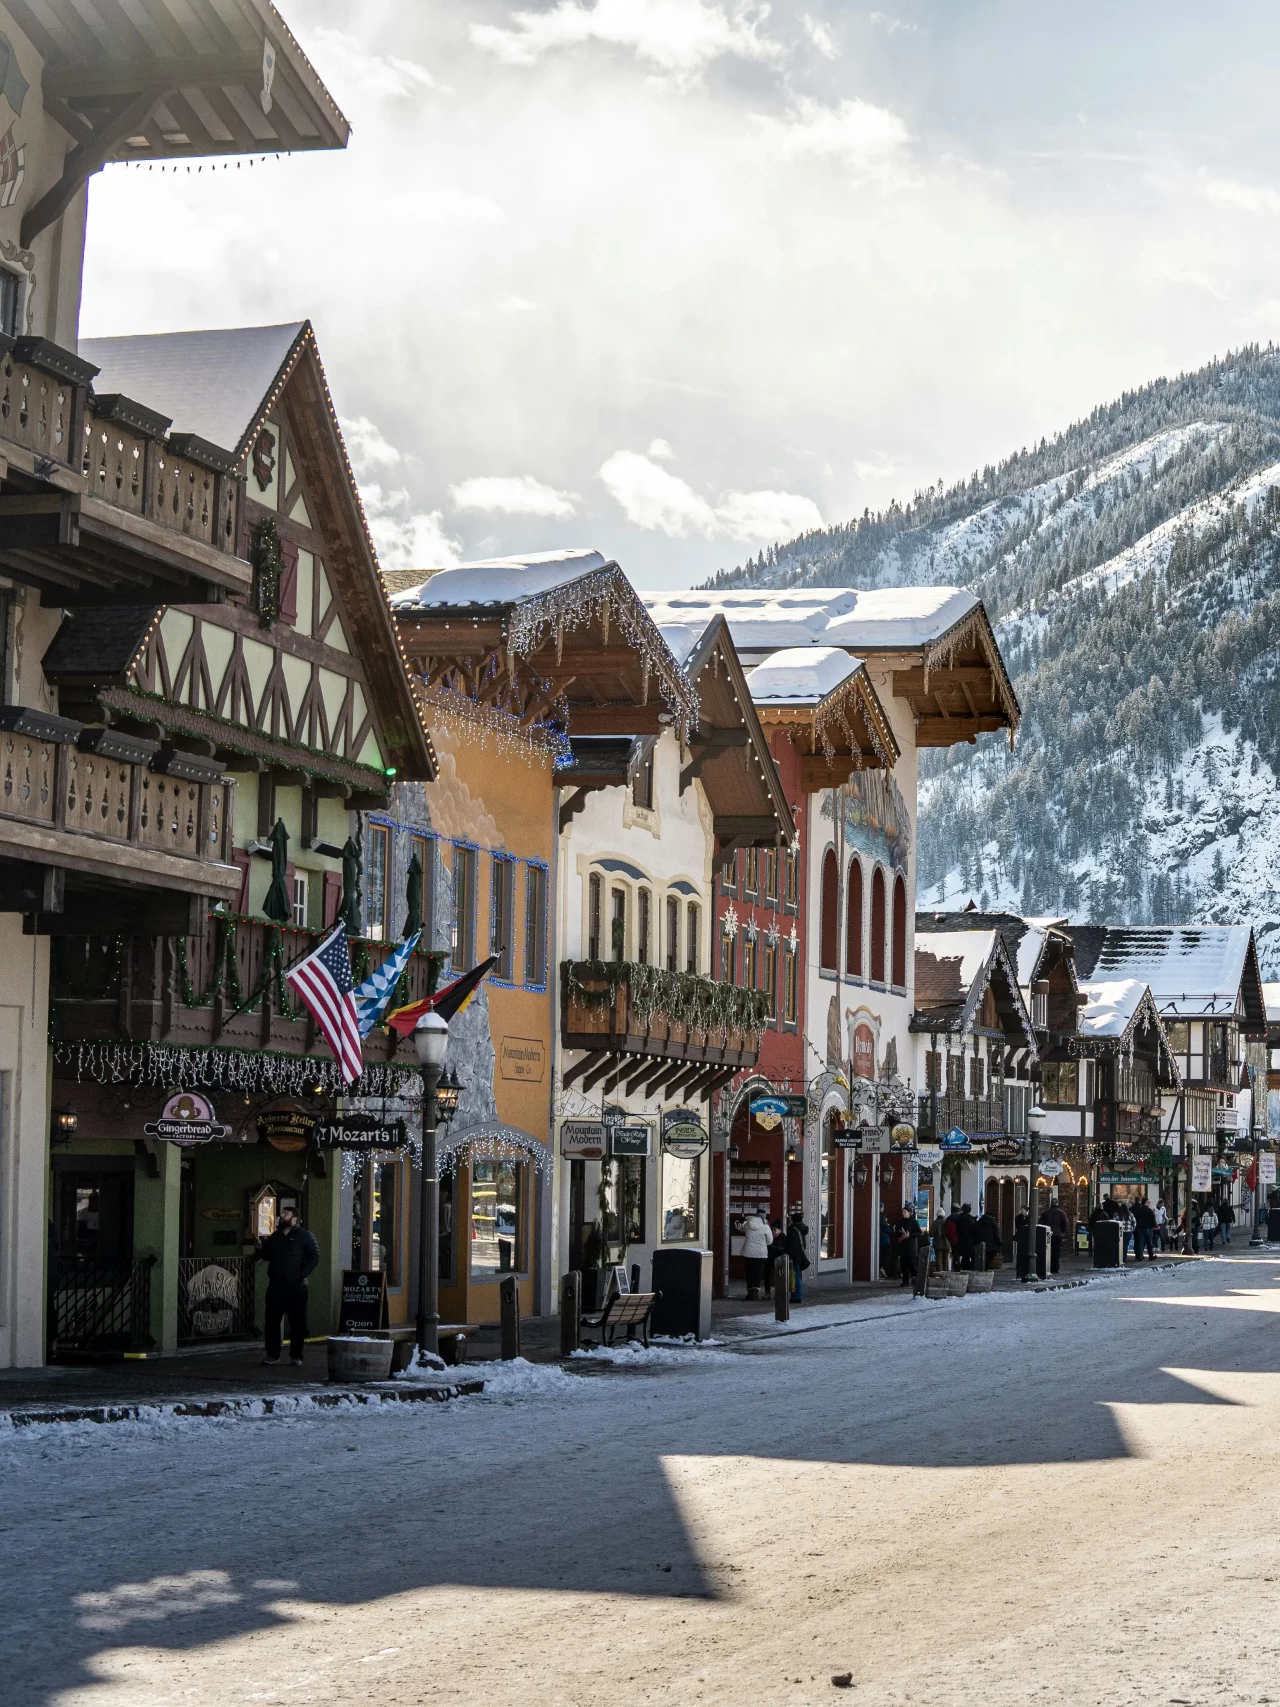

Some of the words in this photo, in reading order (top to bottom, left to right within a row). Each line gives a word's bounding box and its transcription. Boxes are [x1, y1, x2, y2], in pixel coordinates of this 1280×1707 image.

[158, 1123, 212, 1135] Gingerbread
[565, 1125, 602, 1135] Mountain
[329, 1126, 390, 1144] Mozart's
[569, 1134, 602, 1144] Modern
[346, 1319, 373, 1327] Open
